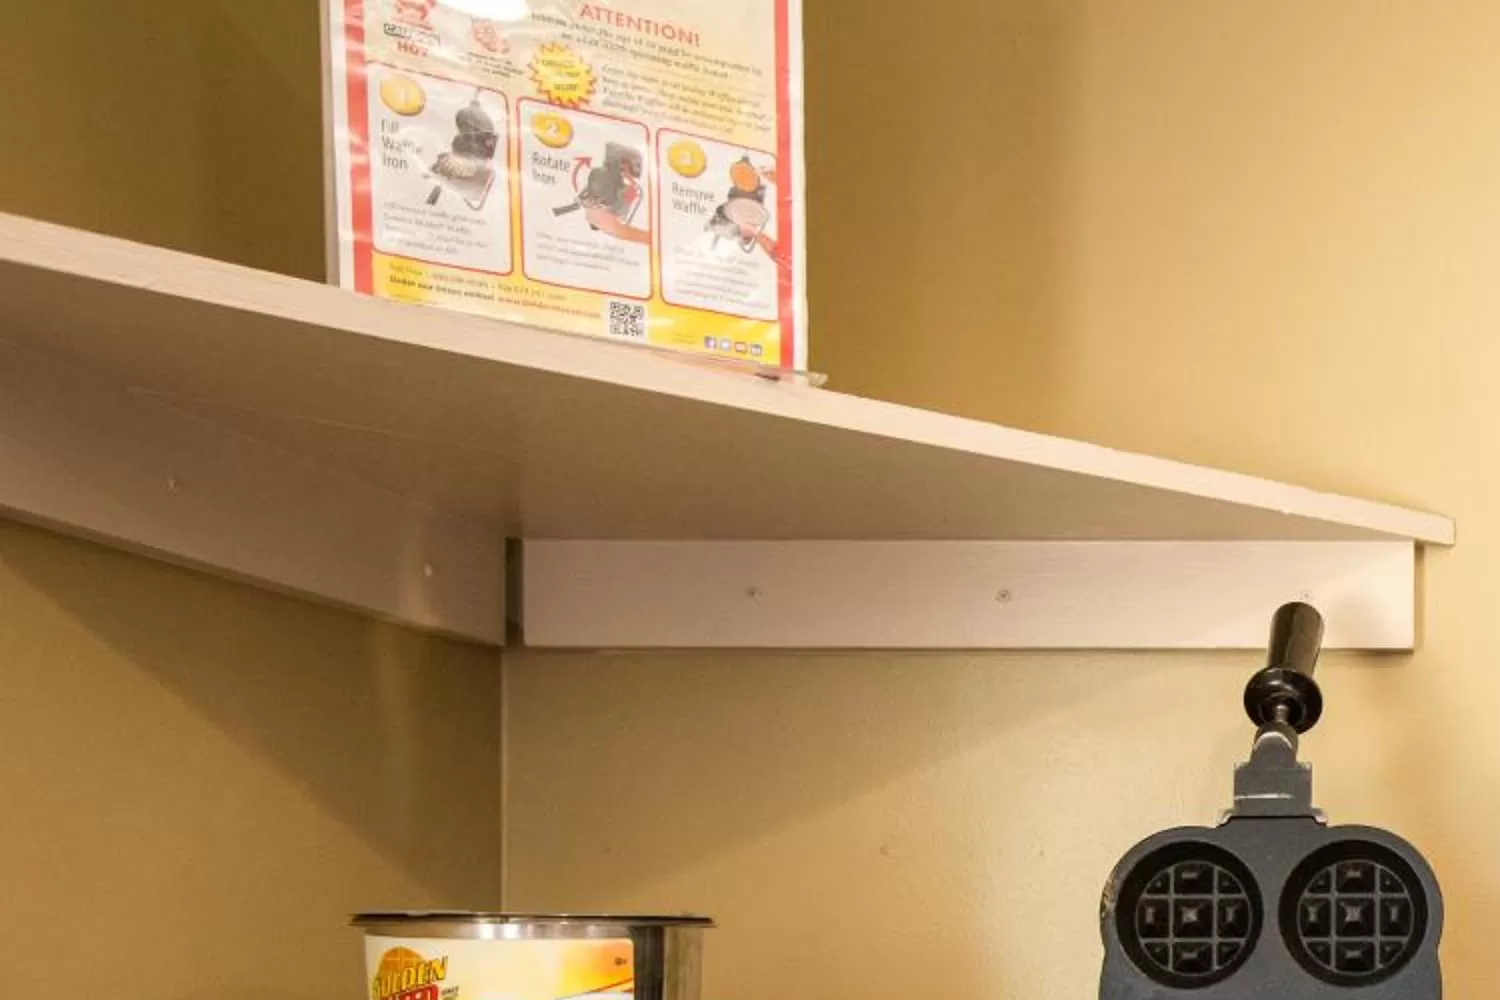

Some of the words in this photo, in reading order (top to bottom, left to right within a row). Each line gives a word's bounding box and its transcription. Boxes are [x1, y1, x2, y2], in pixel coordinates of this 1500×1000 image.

[580, 3, 700, 47] ATTENTION!
[397, 41, 428, 57] HO
[546, 121, 559, 138] 2
[532, 151, 571, 173] Rotate
